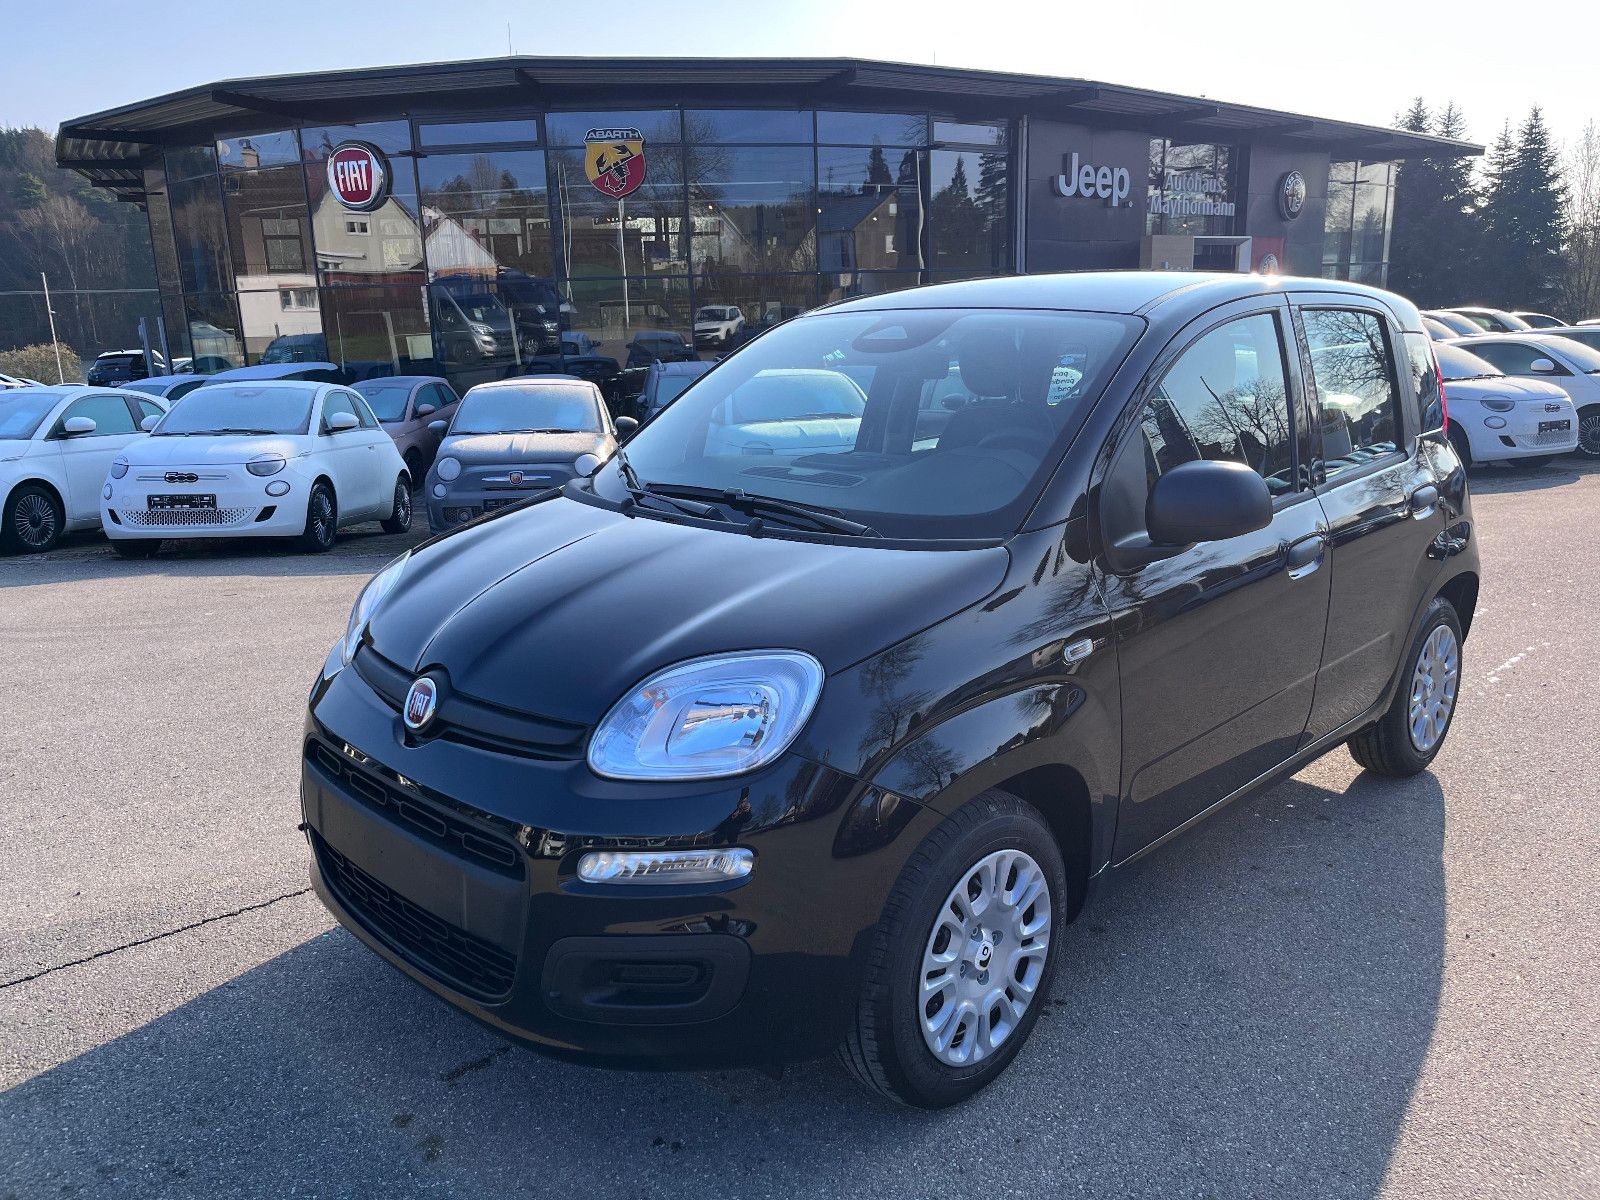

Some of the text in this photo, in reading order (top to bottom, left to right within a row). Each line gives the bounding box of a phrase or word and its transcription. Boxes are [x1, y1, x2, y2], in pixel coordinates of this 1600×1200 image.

[588, 130, 639, 139] ABARTH
[337, 160, 368, 192] FIAT
[1164, 172, 1223, 193] Autohaus
[410, 691, 430, 717] FIAT
